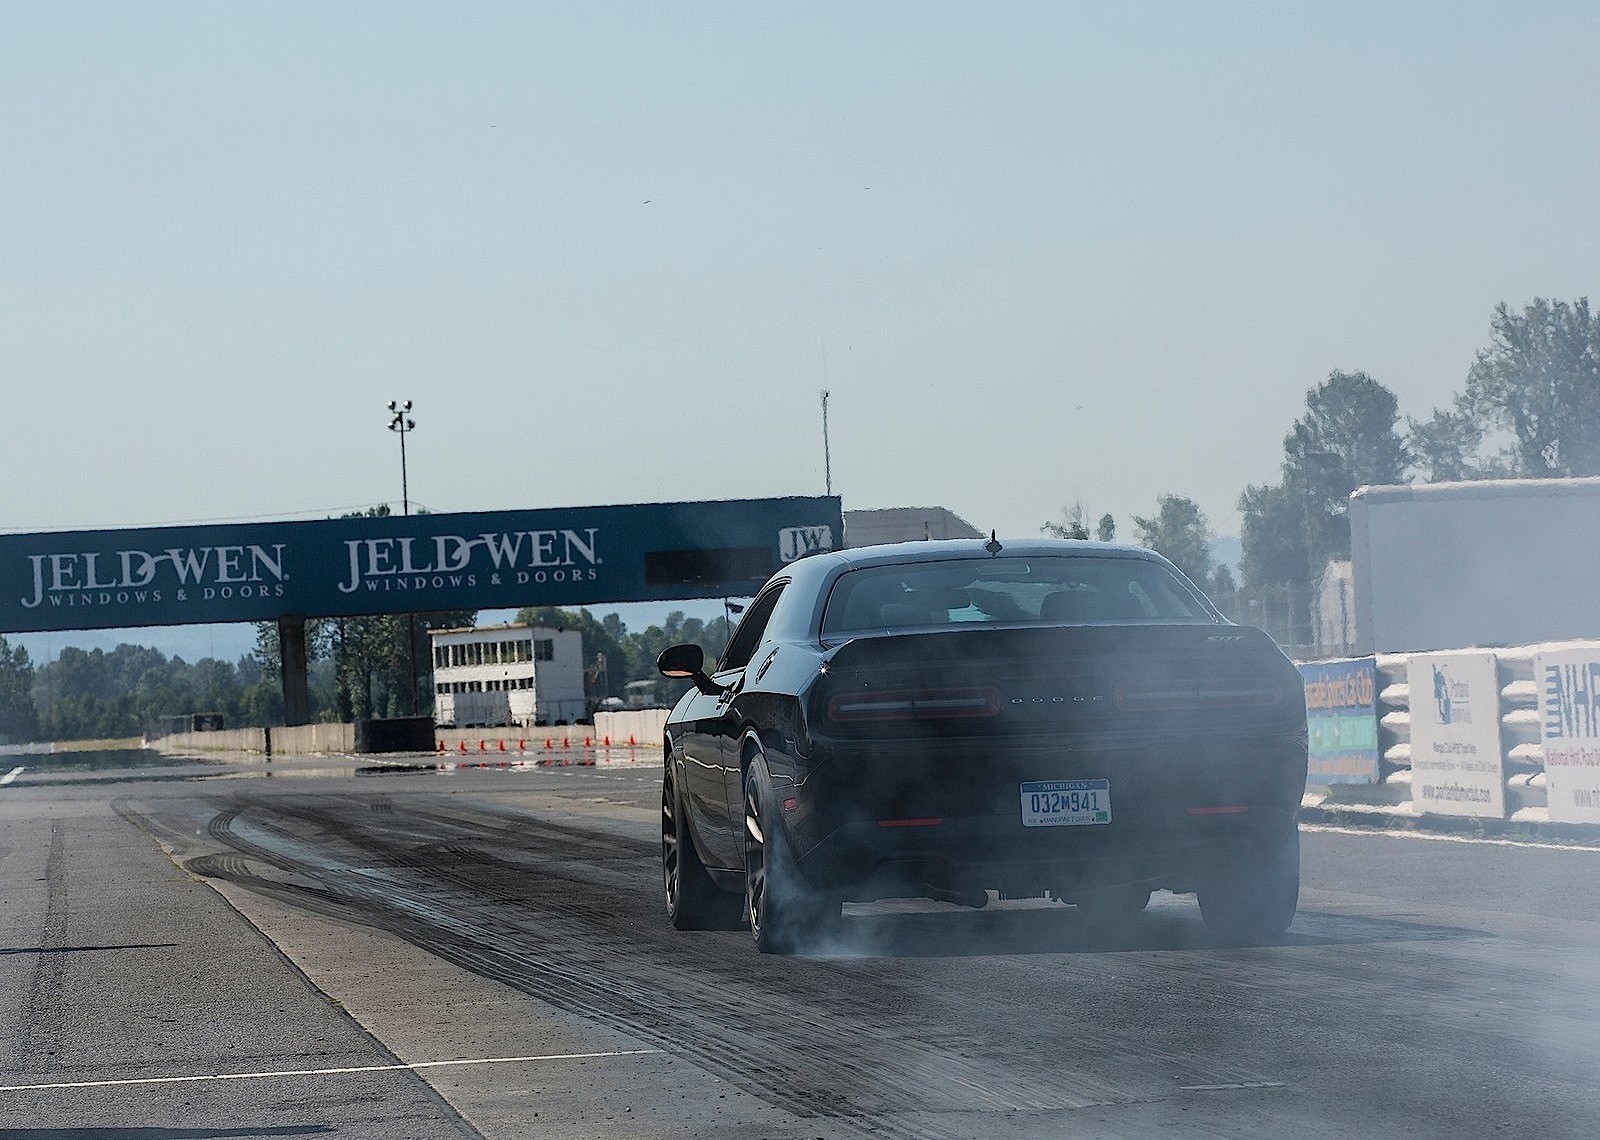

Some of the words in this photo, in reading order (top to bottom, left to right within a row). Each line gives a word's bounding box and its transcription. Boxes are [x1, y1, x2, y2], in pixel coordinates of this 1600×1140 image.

[366, 575, 476, 591] WINDOWS
[491, 573, 501, 585] &
[517, 568, 597, 584] DOORS
[49, 589, 161, 606] WINDOWS
[176, 588, 188, 601] &
[203, 583, 285, 600] DOORS
[1010, 695, 1104, 704] DODGE
[1043, 782, 1087, 792] MICHIGAN
[1031, 792, 1099, 813] 032M941
